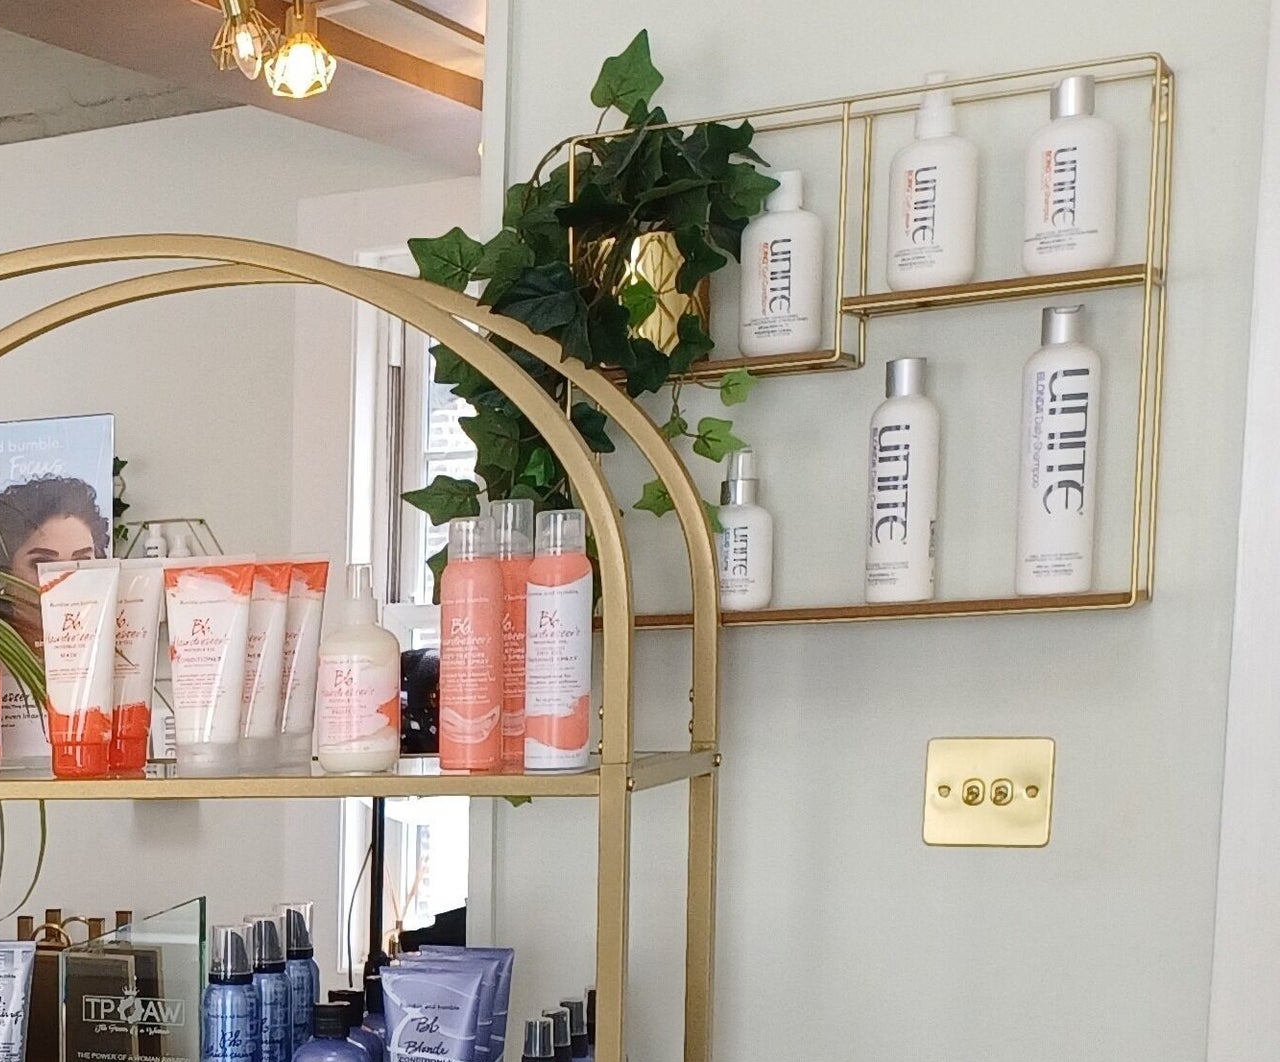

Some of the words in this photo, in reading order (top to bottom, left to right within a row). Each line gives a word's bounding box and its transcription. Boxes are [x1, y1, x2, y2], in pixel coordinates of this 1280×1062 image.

[403, 1040, 450, 1056] Blonde
[77, 1051, 91, 1060] THE
[91, 1052, 117, 1061] POWER
